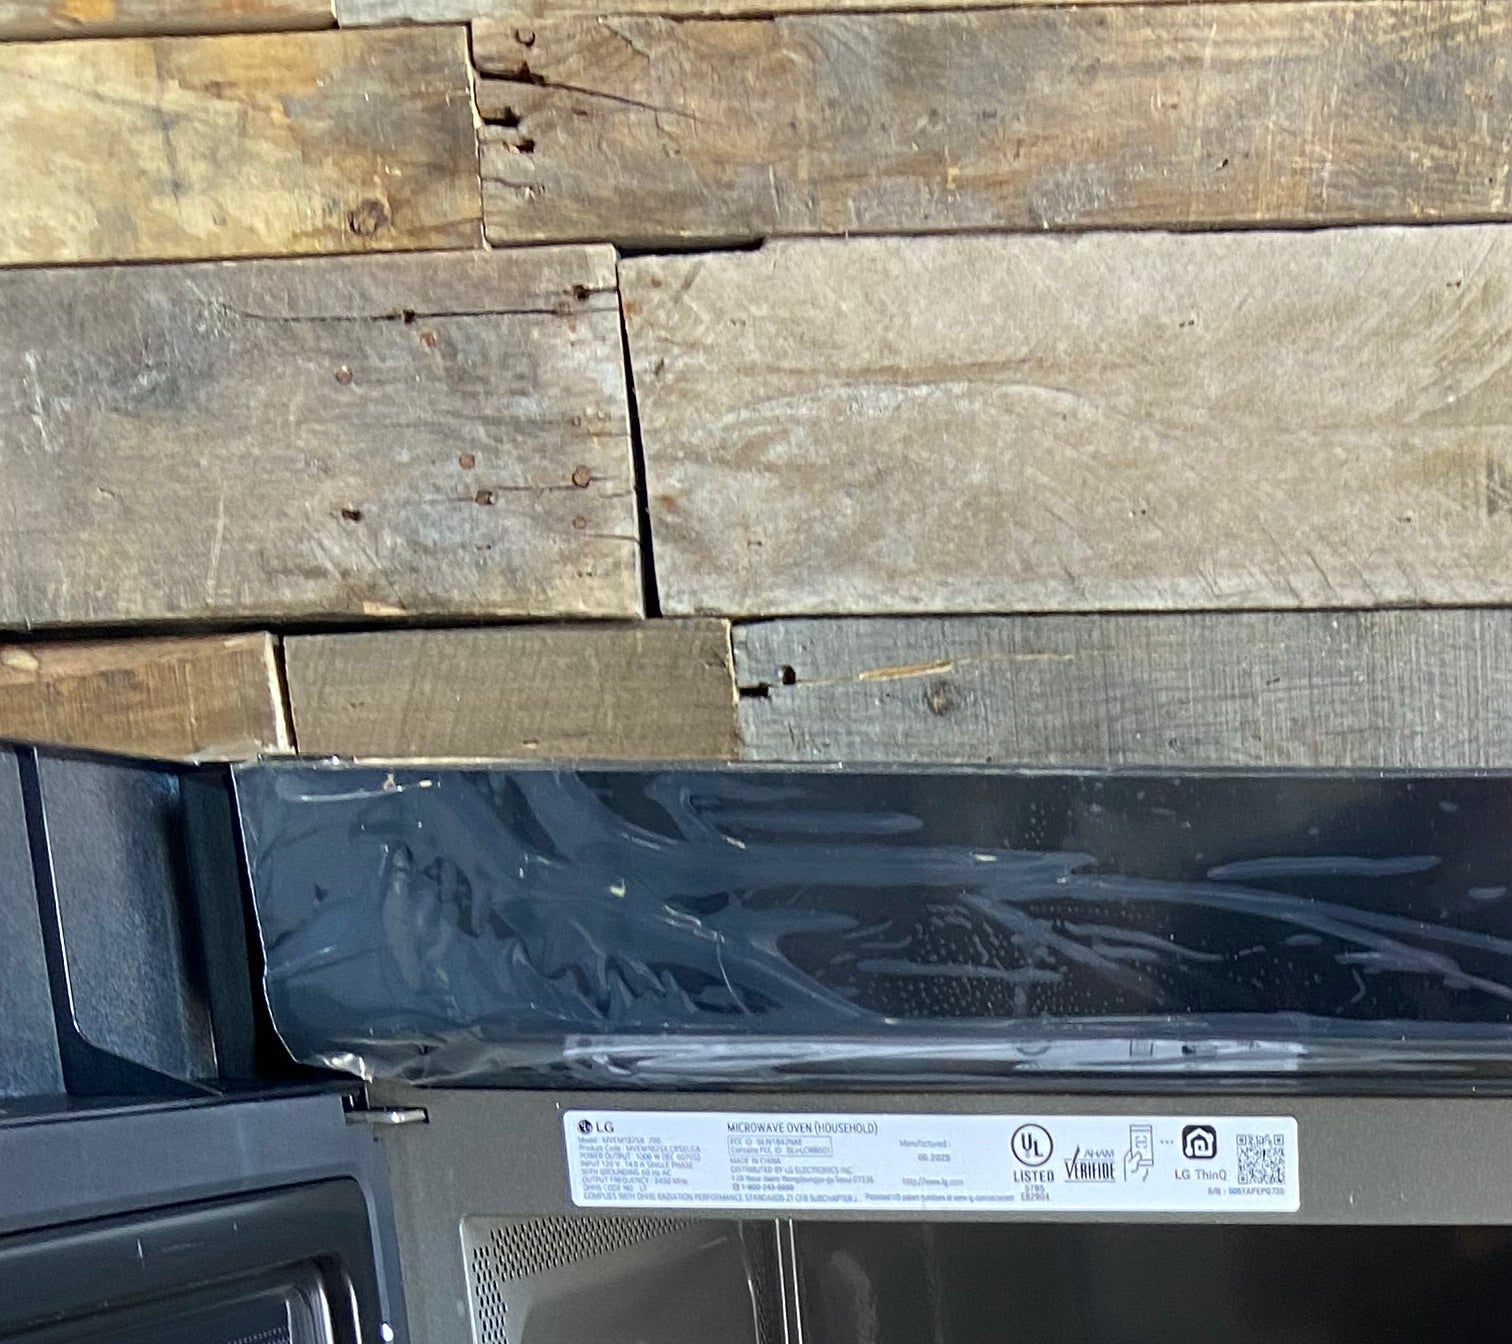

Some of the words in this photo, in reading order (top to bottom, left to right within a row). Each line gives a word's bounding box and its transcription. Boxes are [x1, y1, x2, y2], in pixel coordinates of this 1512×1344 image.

[596, 1121, 614, 1133] LG
[727, 1121, 784, 1134] MICROWAVE
[787, 1122, 812, 1134] OVEN
[814, 1121, 878, 1136] (HOUSEHOLD)
[1014, 1170, 1054, 1183] LISTED
[1175, 1170, 1190, 1180] LG
[1196, 1169, 1227, 1181] ThinQ
